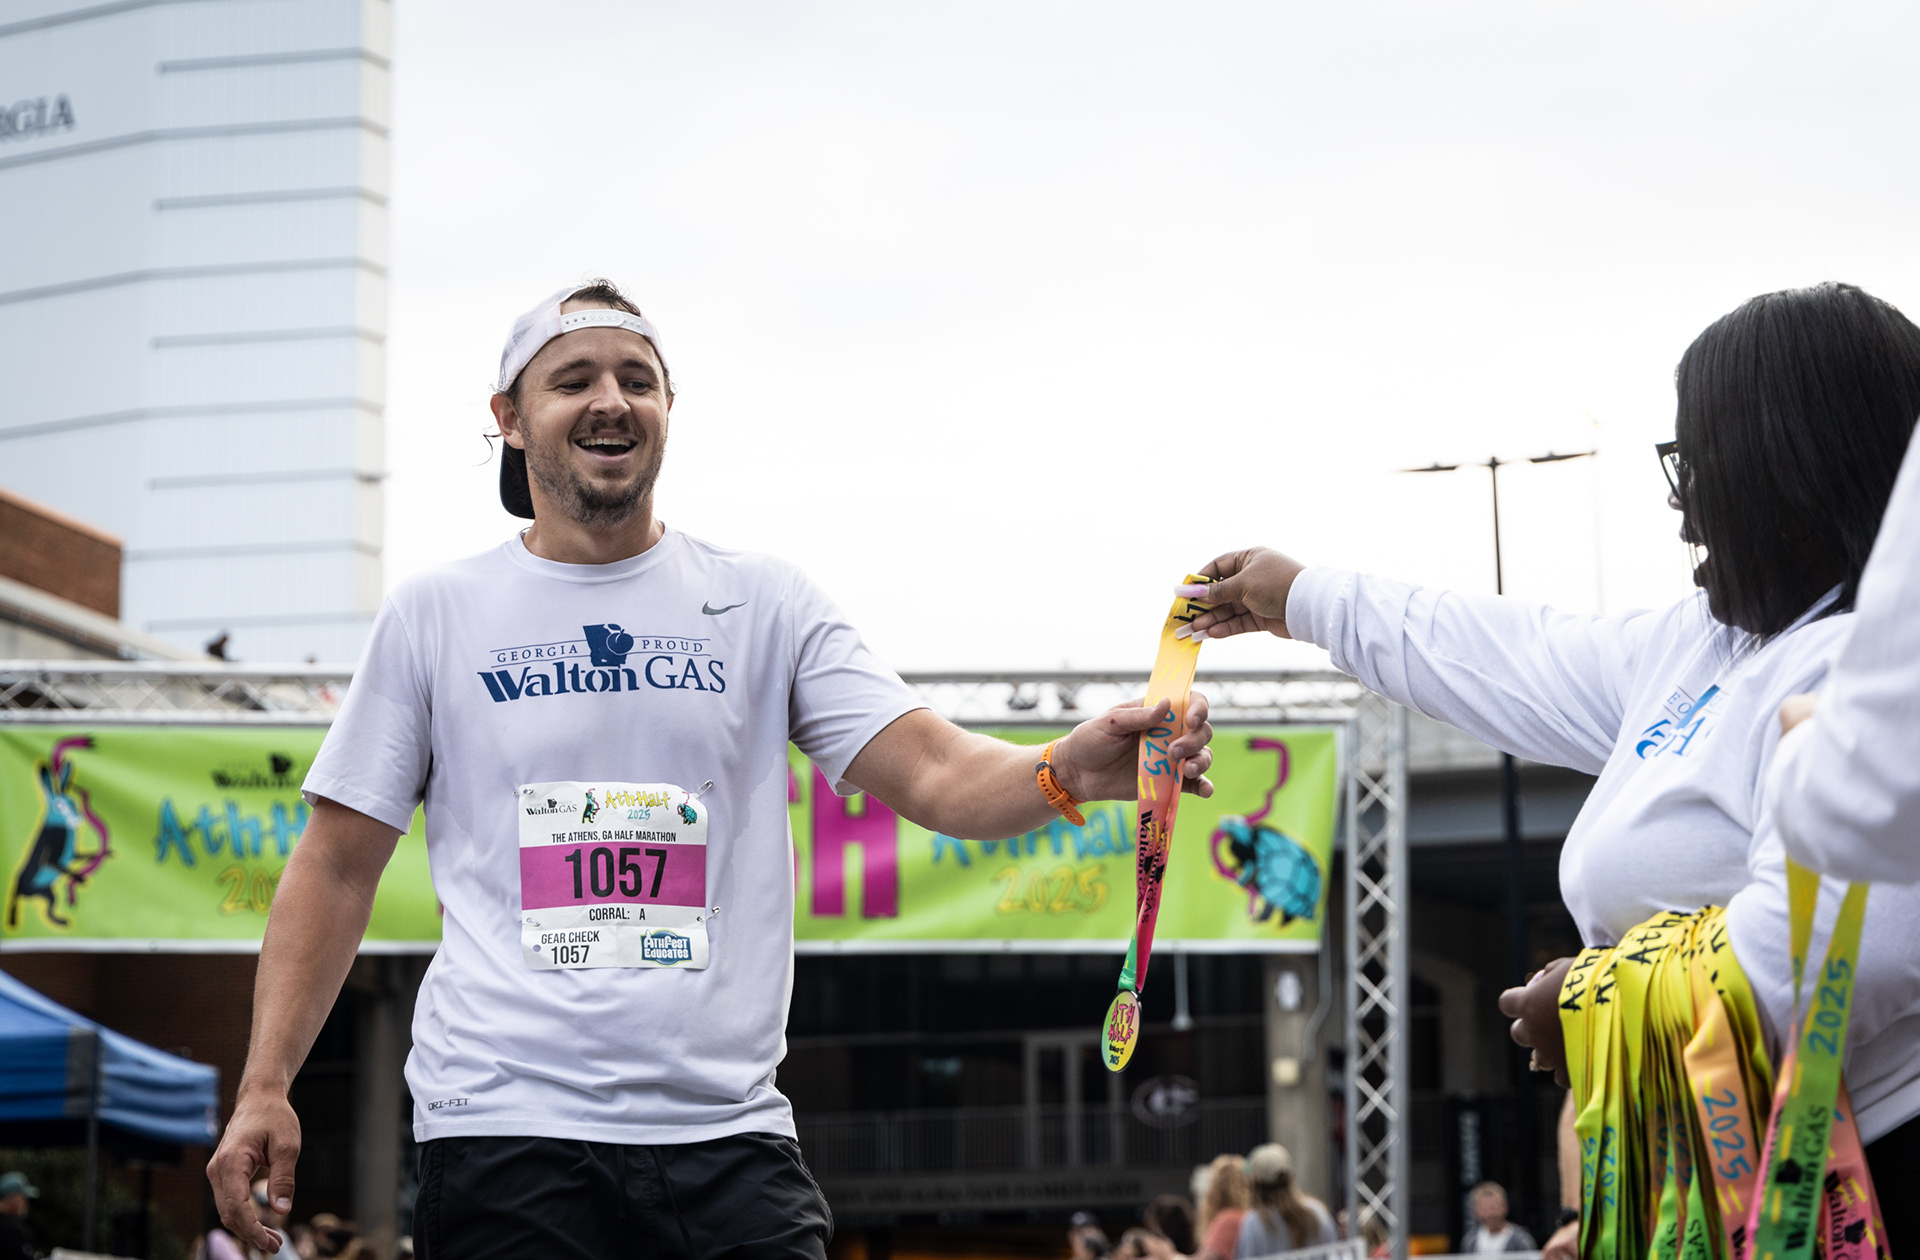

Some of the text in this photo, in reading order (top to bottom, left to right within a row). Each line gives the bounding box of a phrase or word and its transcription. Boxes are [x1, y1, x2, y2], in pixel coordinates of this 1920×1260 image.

[497, 639, 703, 662] GEORGIA PROUD
[477, 655, 726, 702] Walton GAS
[526, 804, 577, 815] Walton GAS
[627, 809, 651, 820] 2025
[552, 830, 676, 843] THE ATHENS, GA HALF MARATHON
[1138, 809, 1154, 874] Walton
[218, 867, 284, 915] 20
[565, 847, 667, 899] 1057
[991, 864, 1110, 914] 2025
[589, 908, 646, 921] CORRAL: A
[1141, 888, 1154, 924] GAS
[541, 931, 600, 944] GEAR CHECK
[551, 945, 590, 965] 1057
[1625, 911, 1688, 966] Ath
[1559, 945, 1608, 1012] Ath
[1111, 1000, 1135, 1027] ATH
[1808, 957, 1852, 1057] 2025
[1108, 1023, 1134, 1045] HALF
[1702, 1088, 1752, 1180] 2025
[1804, 1105, 1828, 1158] GAS
[1825, 1170, 1847, 1251] Walton
